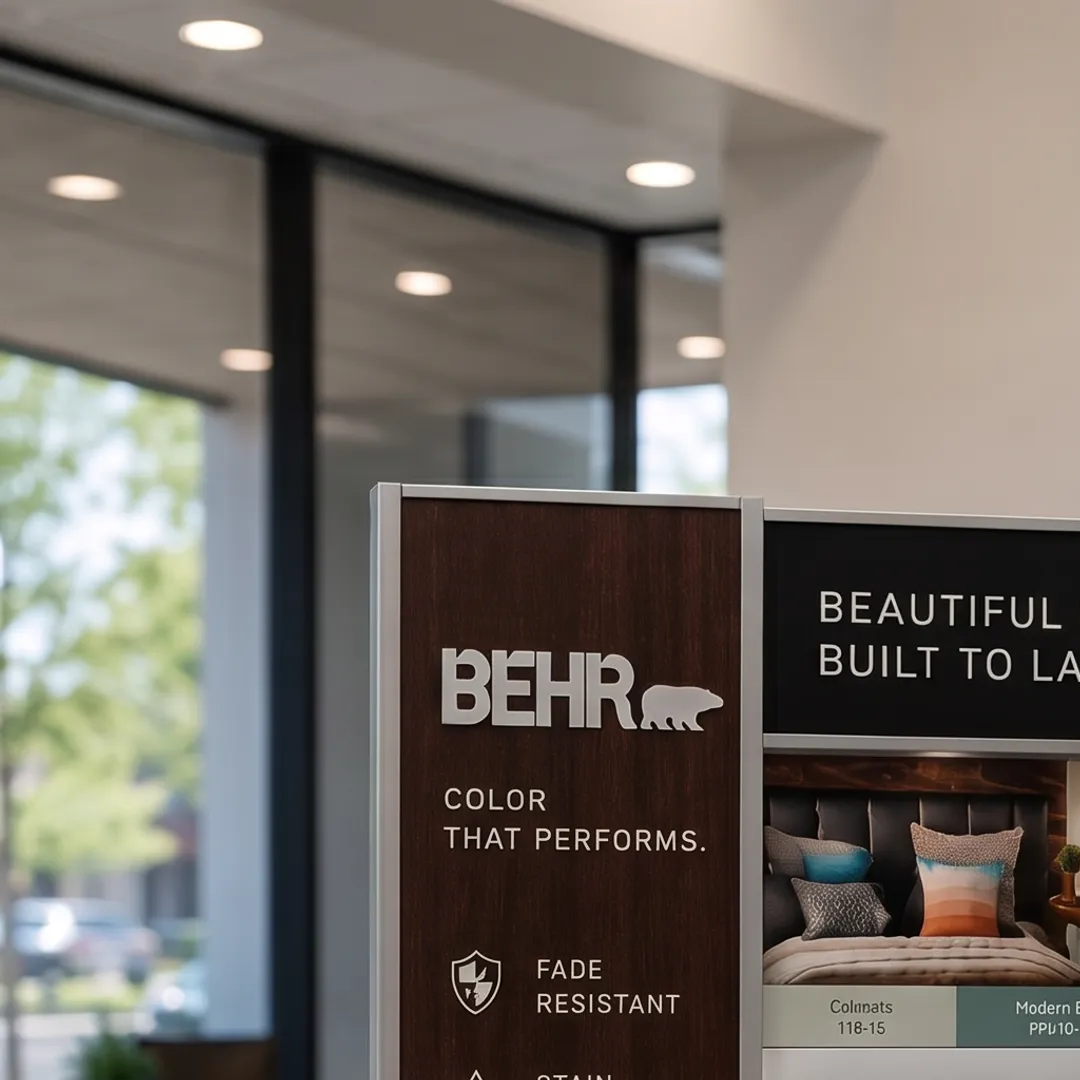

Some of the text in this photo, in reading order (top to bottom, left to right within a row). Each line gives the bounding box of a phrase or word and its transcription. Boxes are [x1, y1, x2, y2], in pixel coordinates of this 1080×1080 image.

[819, 590, 1062, 630] BEAUTIFUL
[819, 643, 940, 679] BUILT
[959, 647, 1012, 681] TO
[441, 648, 638, 730] BEHR
[444, 788, 547, 811] COLOR
[443, 827, 706, 852] THAT PERFORMS.
[537, 959, 602, 980] FADE
[537, 993, 681, 1014] RESISTANT
[1015, 1001, 1071, 1015] Modern
[837, 1021, 886, 1035] 118-15
